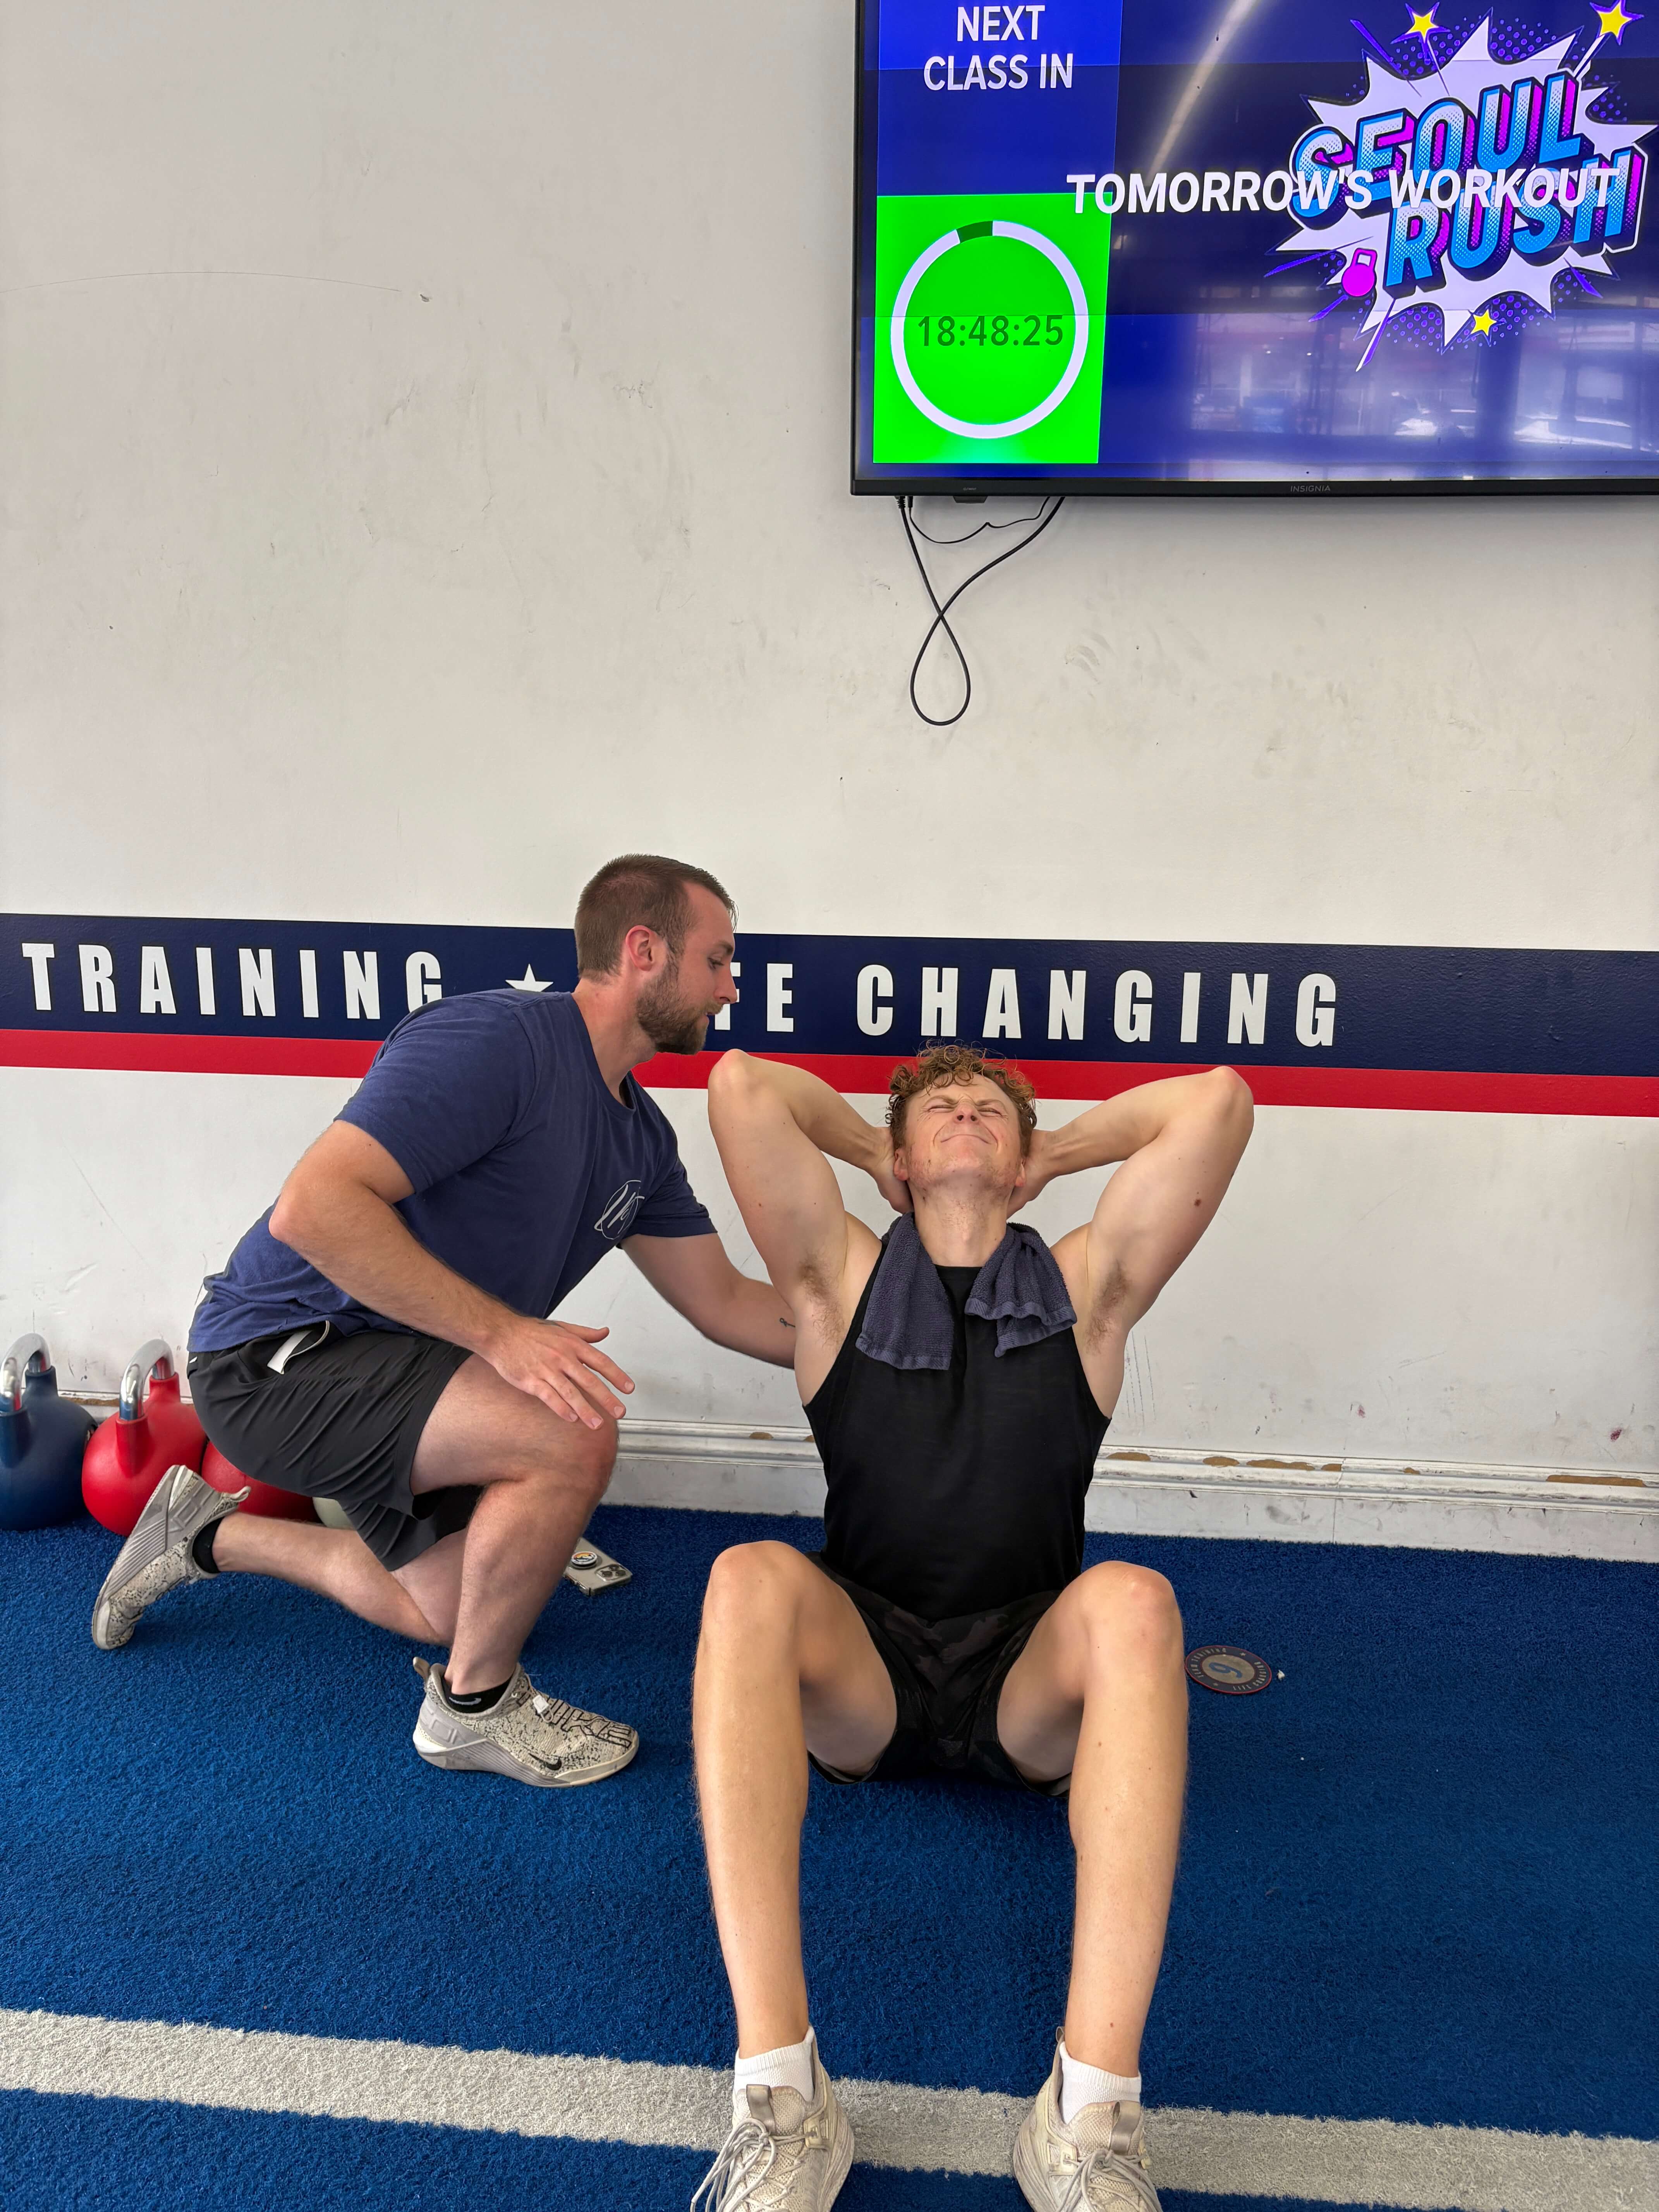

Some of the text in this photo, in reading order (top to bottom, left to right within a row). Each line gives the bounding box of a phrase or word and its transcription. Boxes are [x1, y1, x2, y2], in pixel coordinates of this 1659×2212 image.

[957, 5, 1046, 41] NEXT
[924, 53, 1073, 91] CLASS IN
[1291, 72, 1592, 225] SEOUL
[1066, 167, 1621, 214] TOMORROW'S WORKOUT
[1384, 149, 1641, 295] RUSH
[917, 314, 1064, 347] 18:48:25
[22, 943, 442, 1020] TRAINING
[856, 964, 1337, 1047] CHANGING
